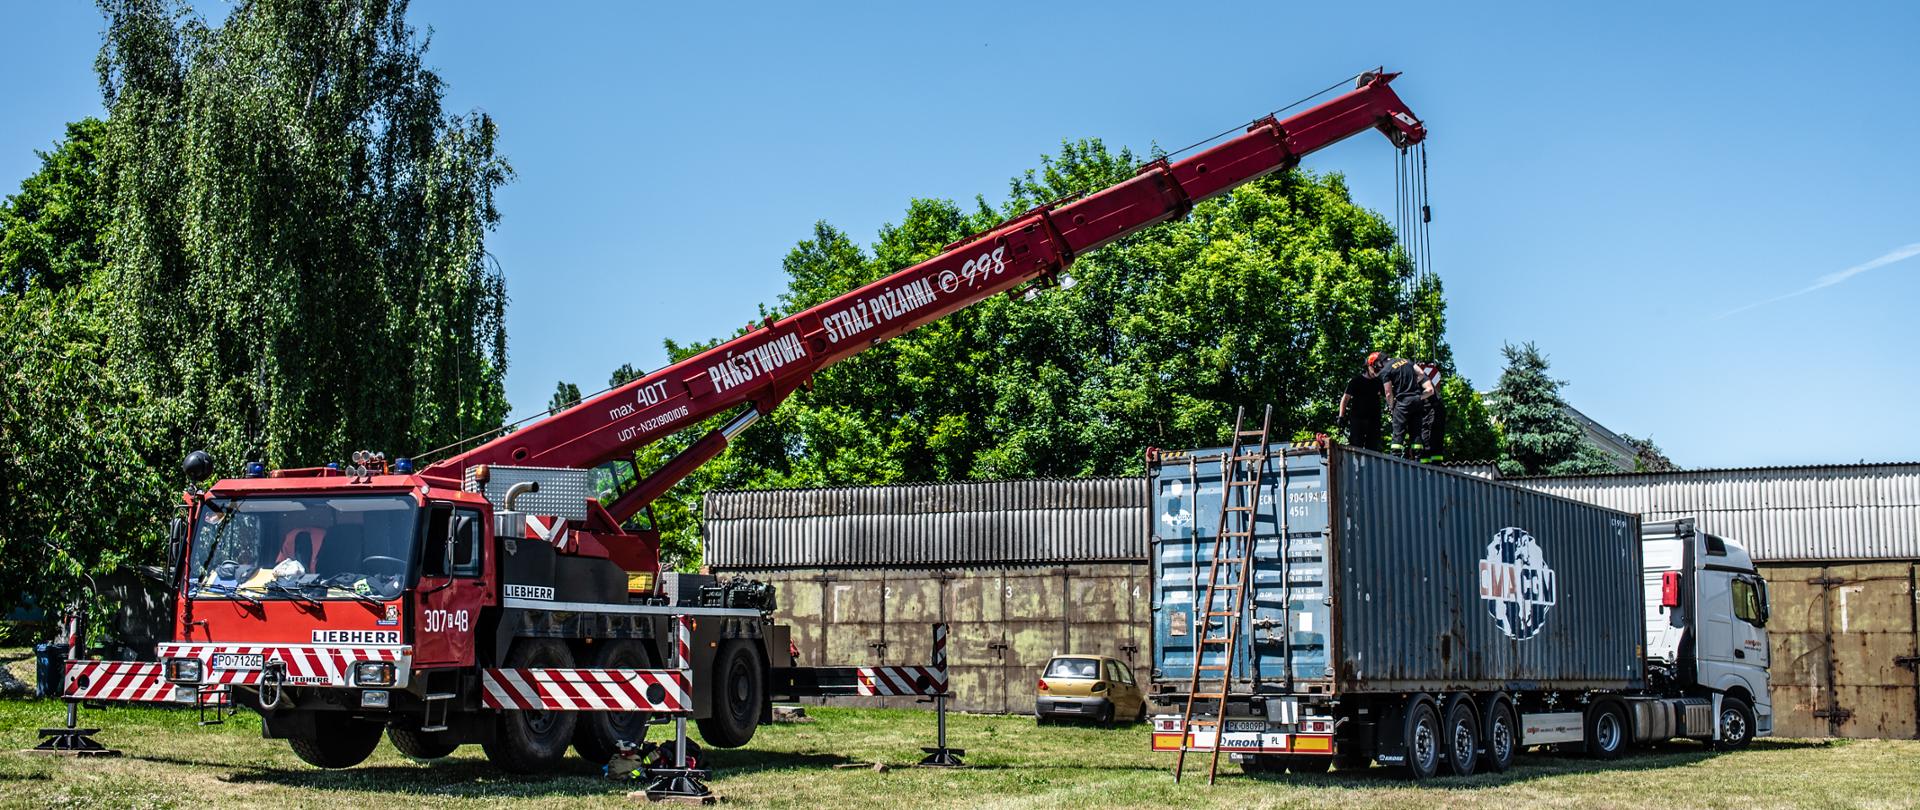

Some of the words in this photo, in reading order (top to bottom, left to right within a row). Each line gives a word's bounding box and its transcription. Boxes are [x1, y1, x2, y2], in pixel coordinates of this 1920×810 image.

[708, 331, 806, 394] PAŃSTWOWA
[823, 299, 873, 344] STRAŻ
[871, 277, 937, 325] POŻARNA
[961, 246, 1005, 287] 998
[609, 402, 636, 420] max
[637, 379, 669, 407] 40T
[1289, 506, 1309, 517] 45G1
[1479, 562, 1518, 599] CMA
[1520, 568, 1554, 604] CGM
[504, 585, 553, 599] LIEBHERR
[884, 587, 891, 599] 2
[1005, 586, 1013, 599] 3
[1132, 585, 1140, 599] 4
[312, 630, 399, 644] LIEBHERR
[218, 655, 231, 667] PO
[234, 655, 262, 667] 7126E
[1229, 721, 1239, 730] PK
[1227, 739, 1265, 747] KRONE
[1271, 736, 1280, 745] PL
